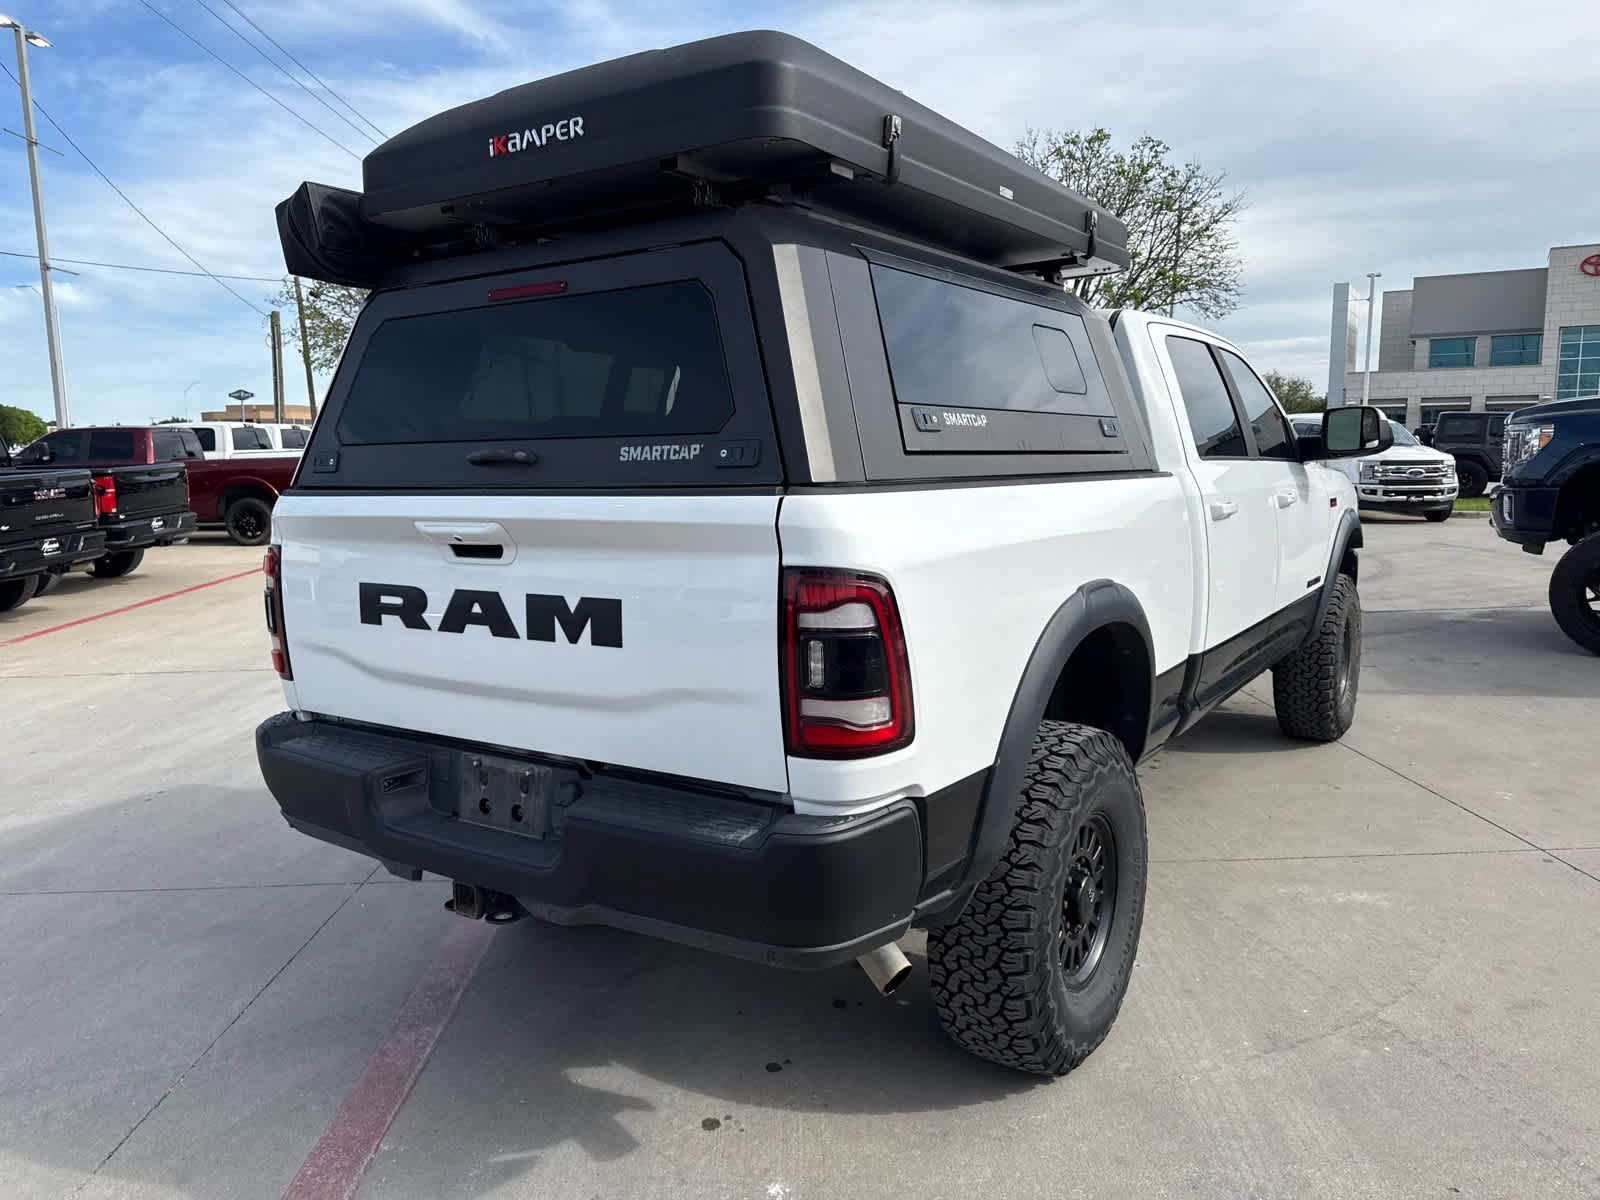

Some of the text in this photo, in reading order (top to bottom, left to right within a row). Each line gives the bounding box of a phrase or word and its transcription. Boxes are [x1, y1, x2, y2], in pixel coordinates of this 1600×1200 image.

[943, 412, 987, 427] SMARTCAP
[619, 444, 703, 462] SMARTCAP
[359, 582, 623, 648] RAM
